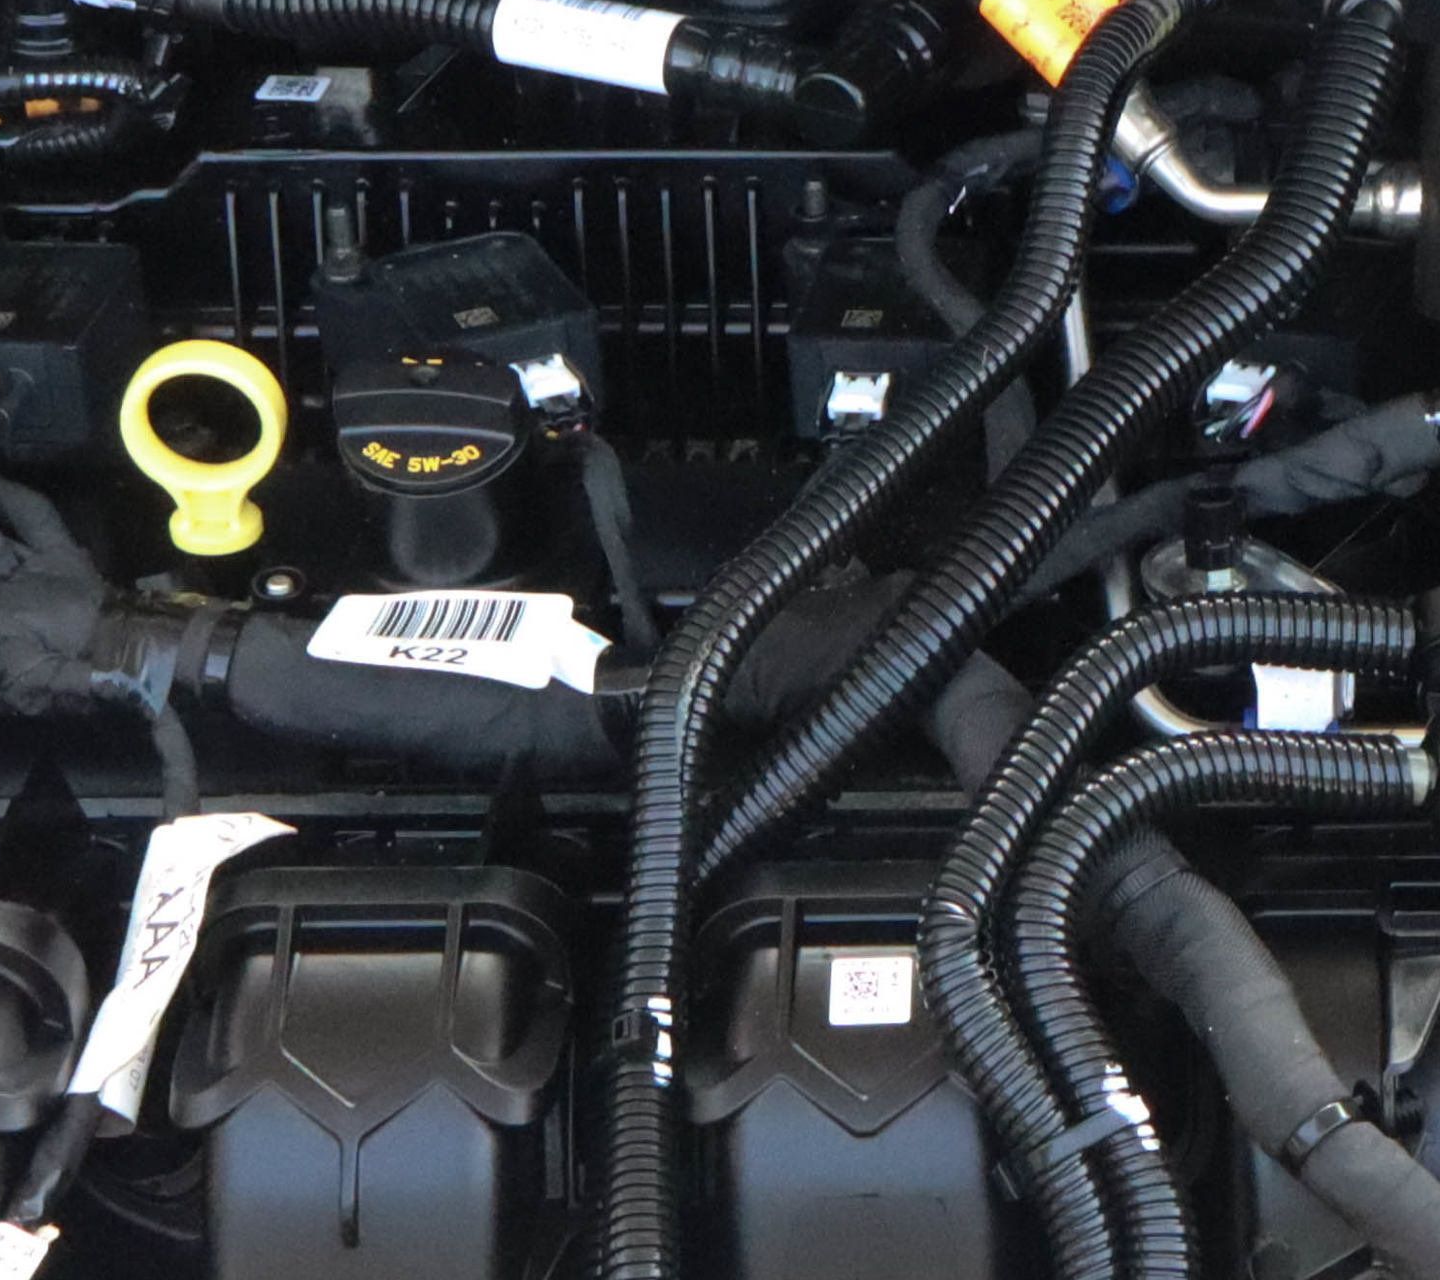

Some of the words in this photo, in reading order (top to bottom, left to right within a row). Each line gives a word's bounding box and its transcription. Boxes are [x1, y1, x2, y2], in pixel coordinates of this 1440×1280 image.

[362, 441, 402, 469] SAE
[407, 444, 481, 473] 5W-30
[388, 645, 469, 665] K22
